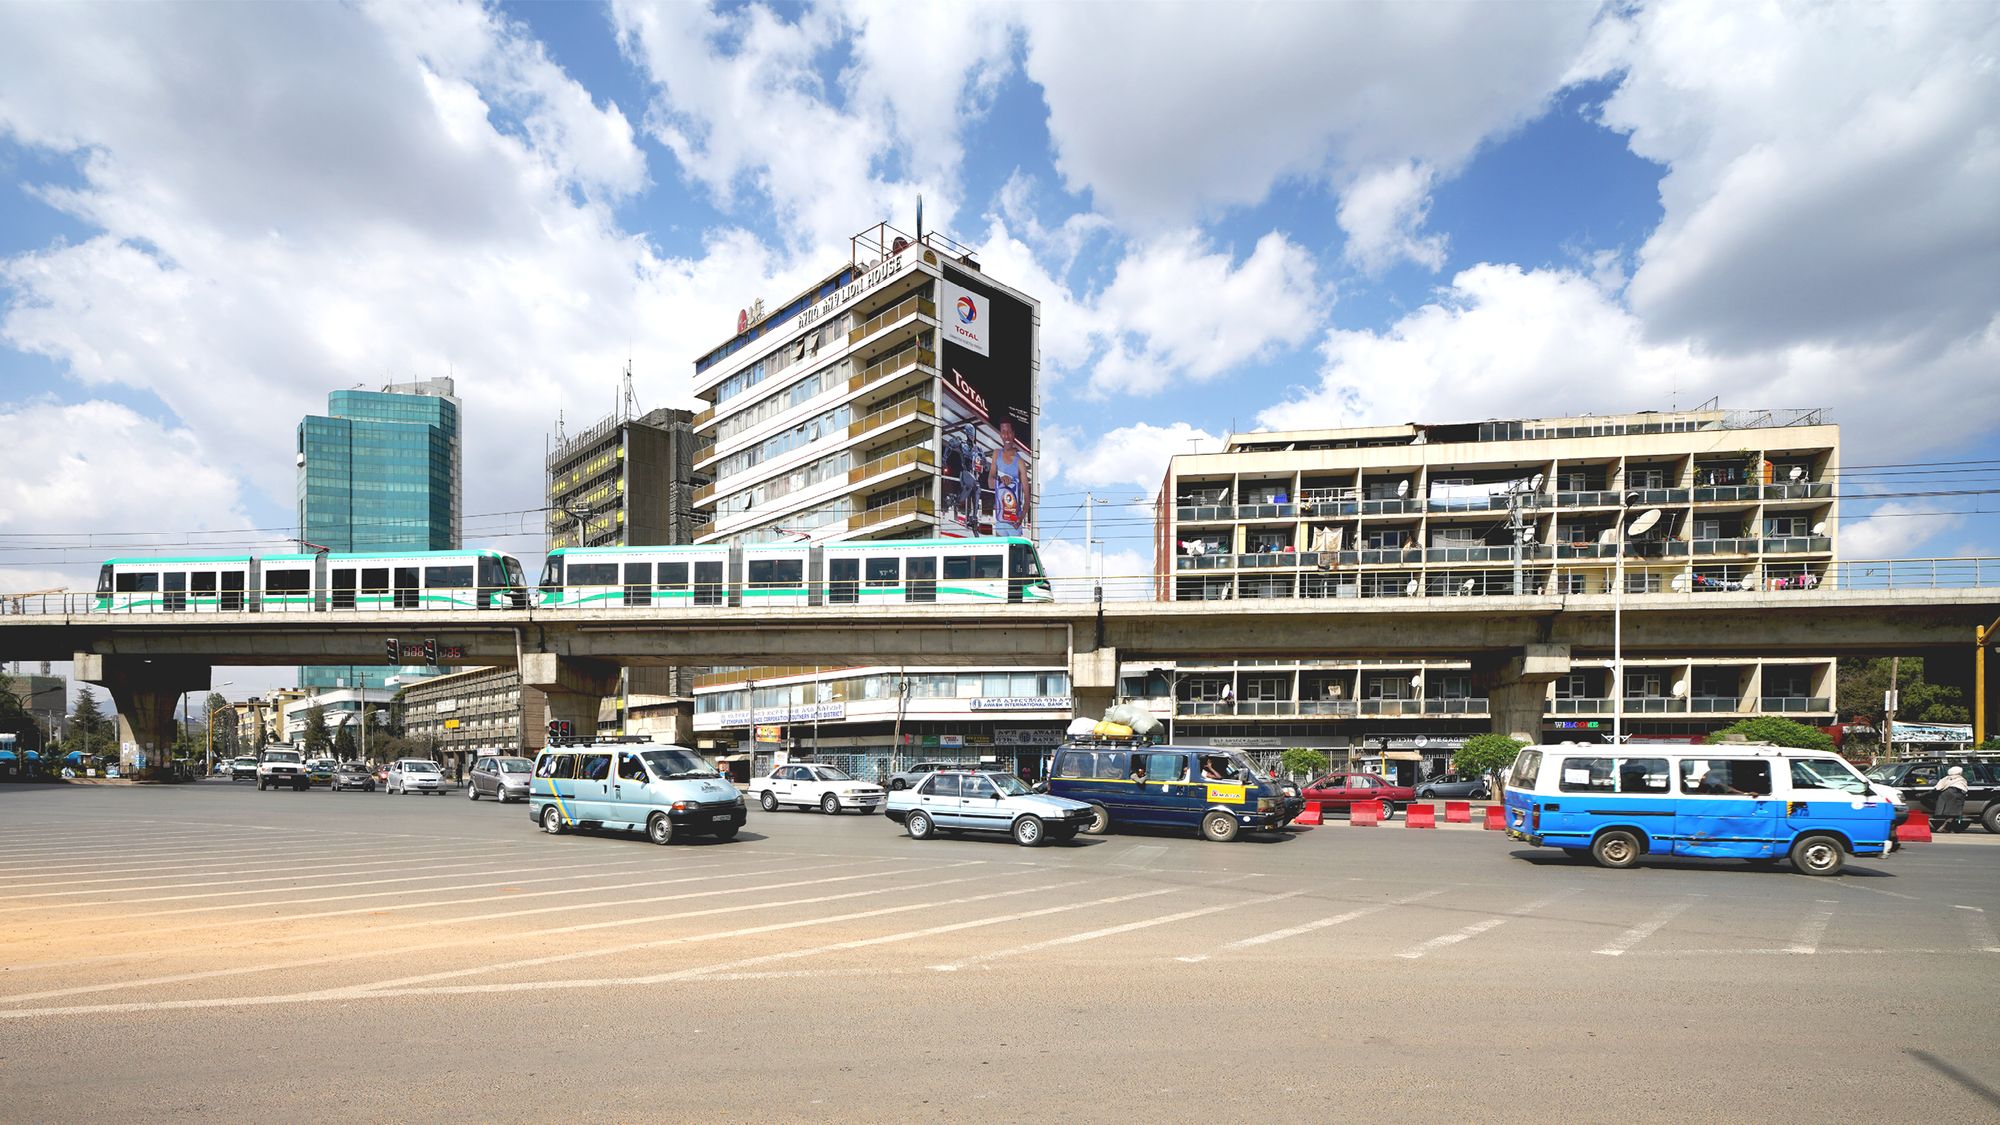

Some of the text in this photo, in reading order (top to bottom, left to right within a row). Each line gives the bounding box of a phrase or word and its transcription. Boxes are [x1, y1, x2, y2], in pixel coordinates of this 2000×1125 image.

[841, 255, 902, 303] LION HOUSE
[955, 325, 979, 341] TOTAL
[952, 368, 989, 411] TOTAL
